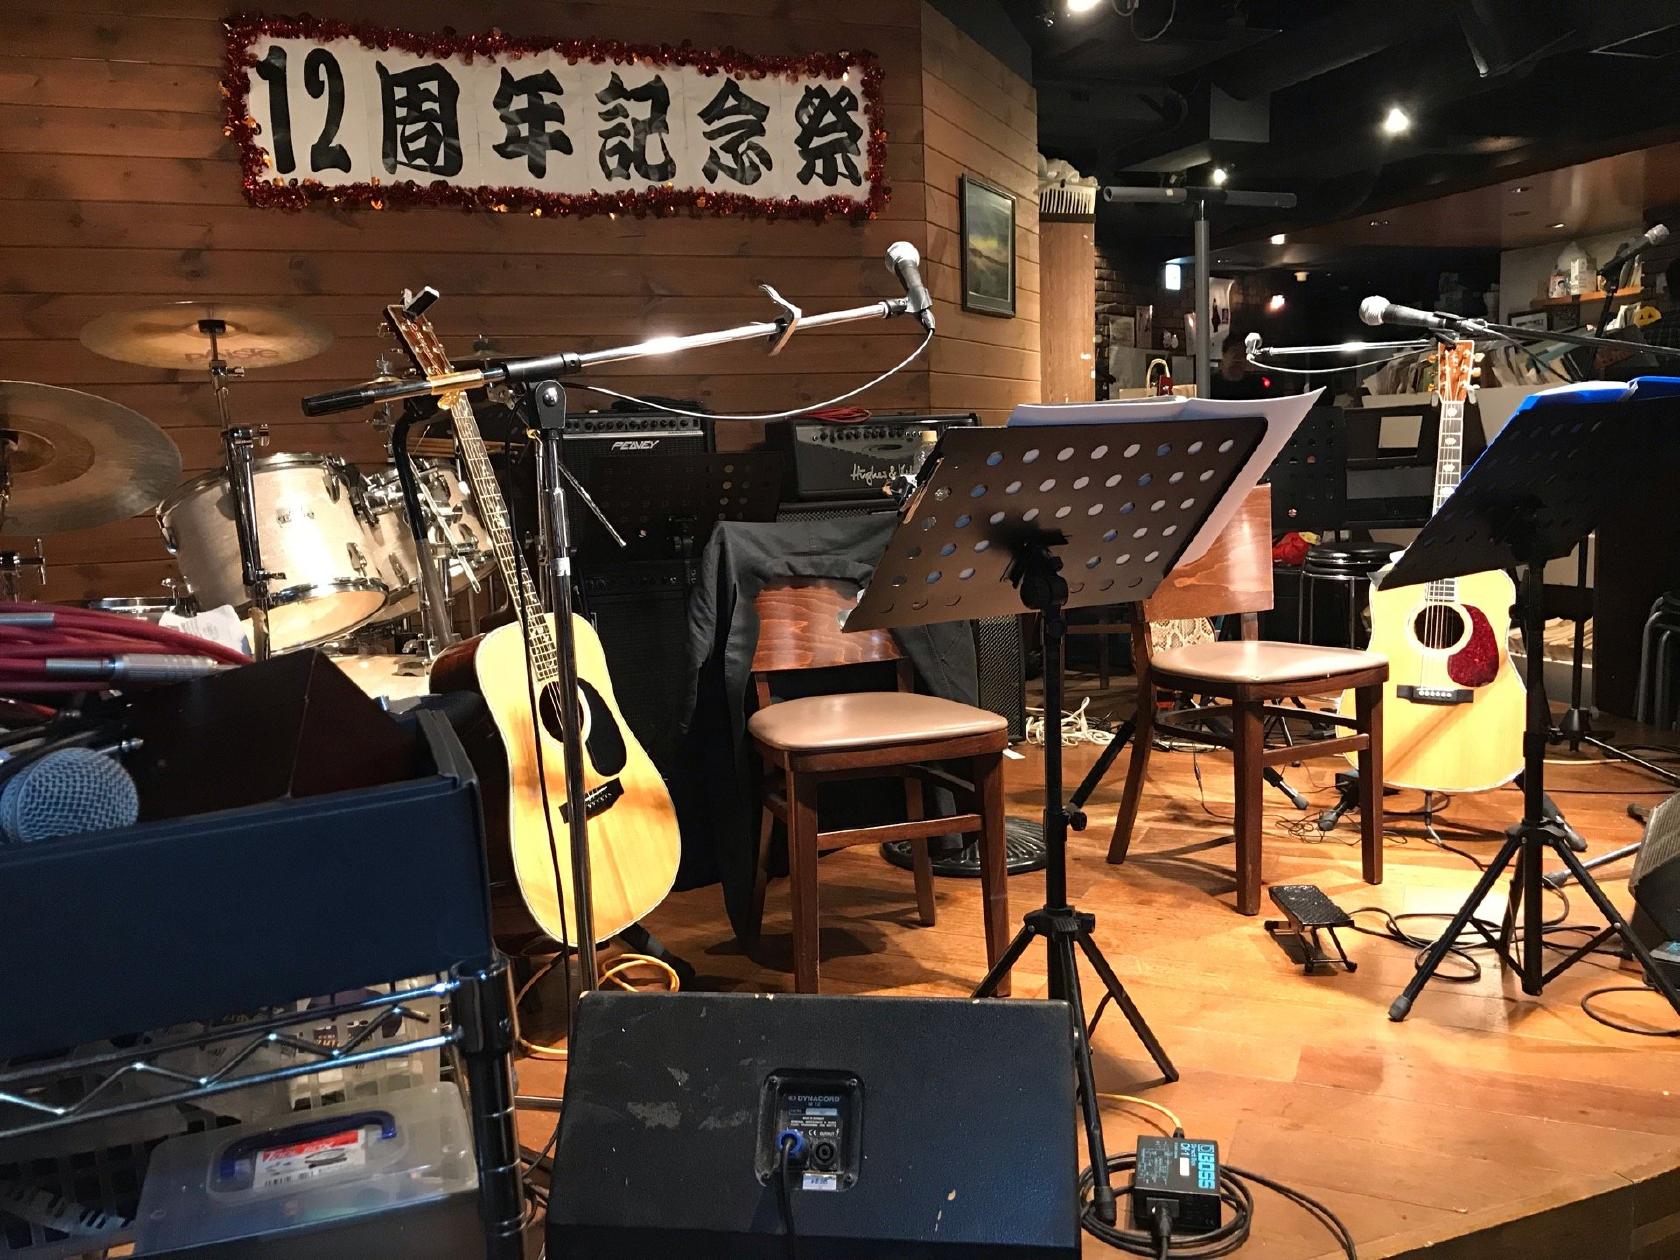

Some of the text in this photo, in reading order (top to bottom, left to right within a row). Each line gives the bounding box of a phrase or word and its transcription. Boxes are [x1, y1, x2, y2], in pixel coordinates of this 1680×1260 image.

[611, 440, 660, 451] PEAVEY
[850, 463, 888, 486] Hughes
[888, 465, 898, 478] &
[1198, 1152, 1215, 1189] BOSS
